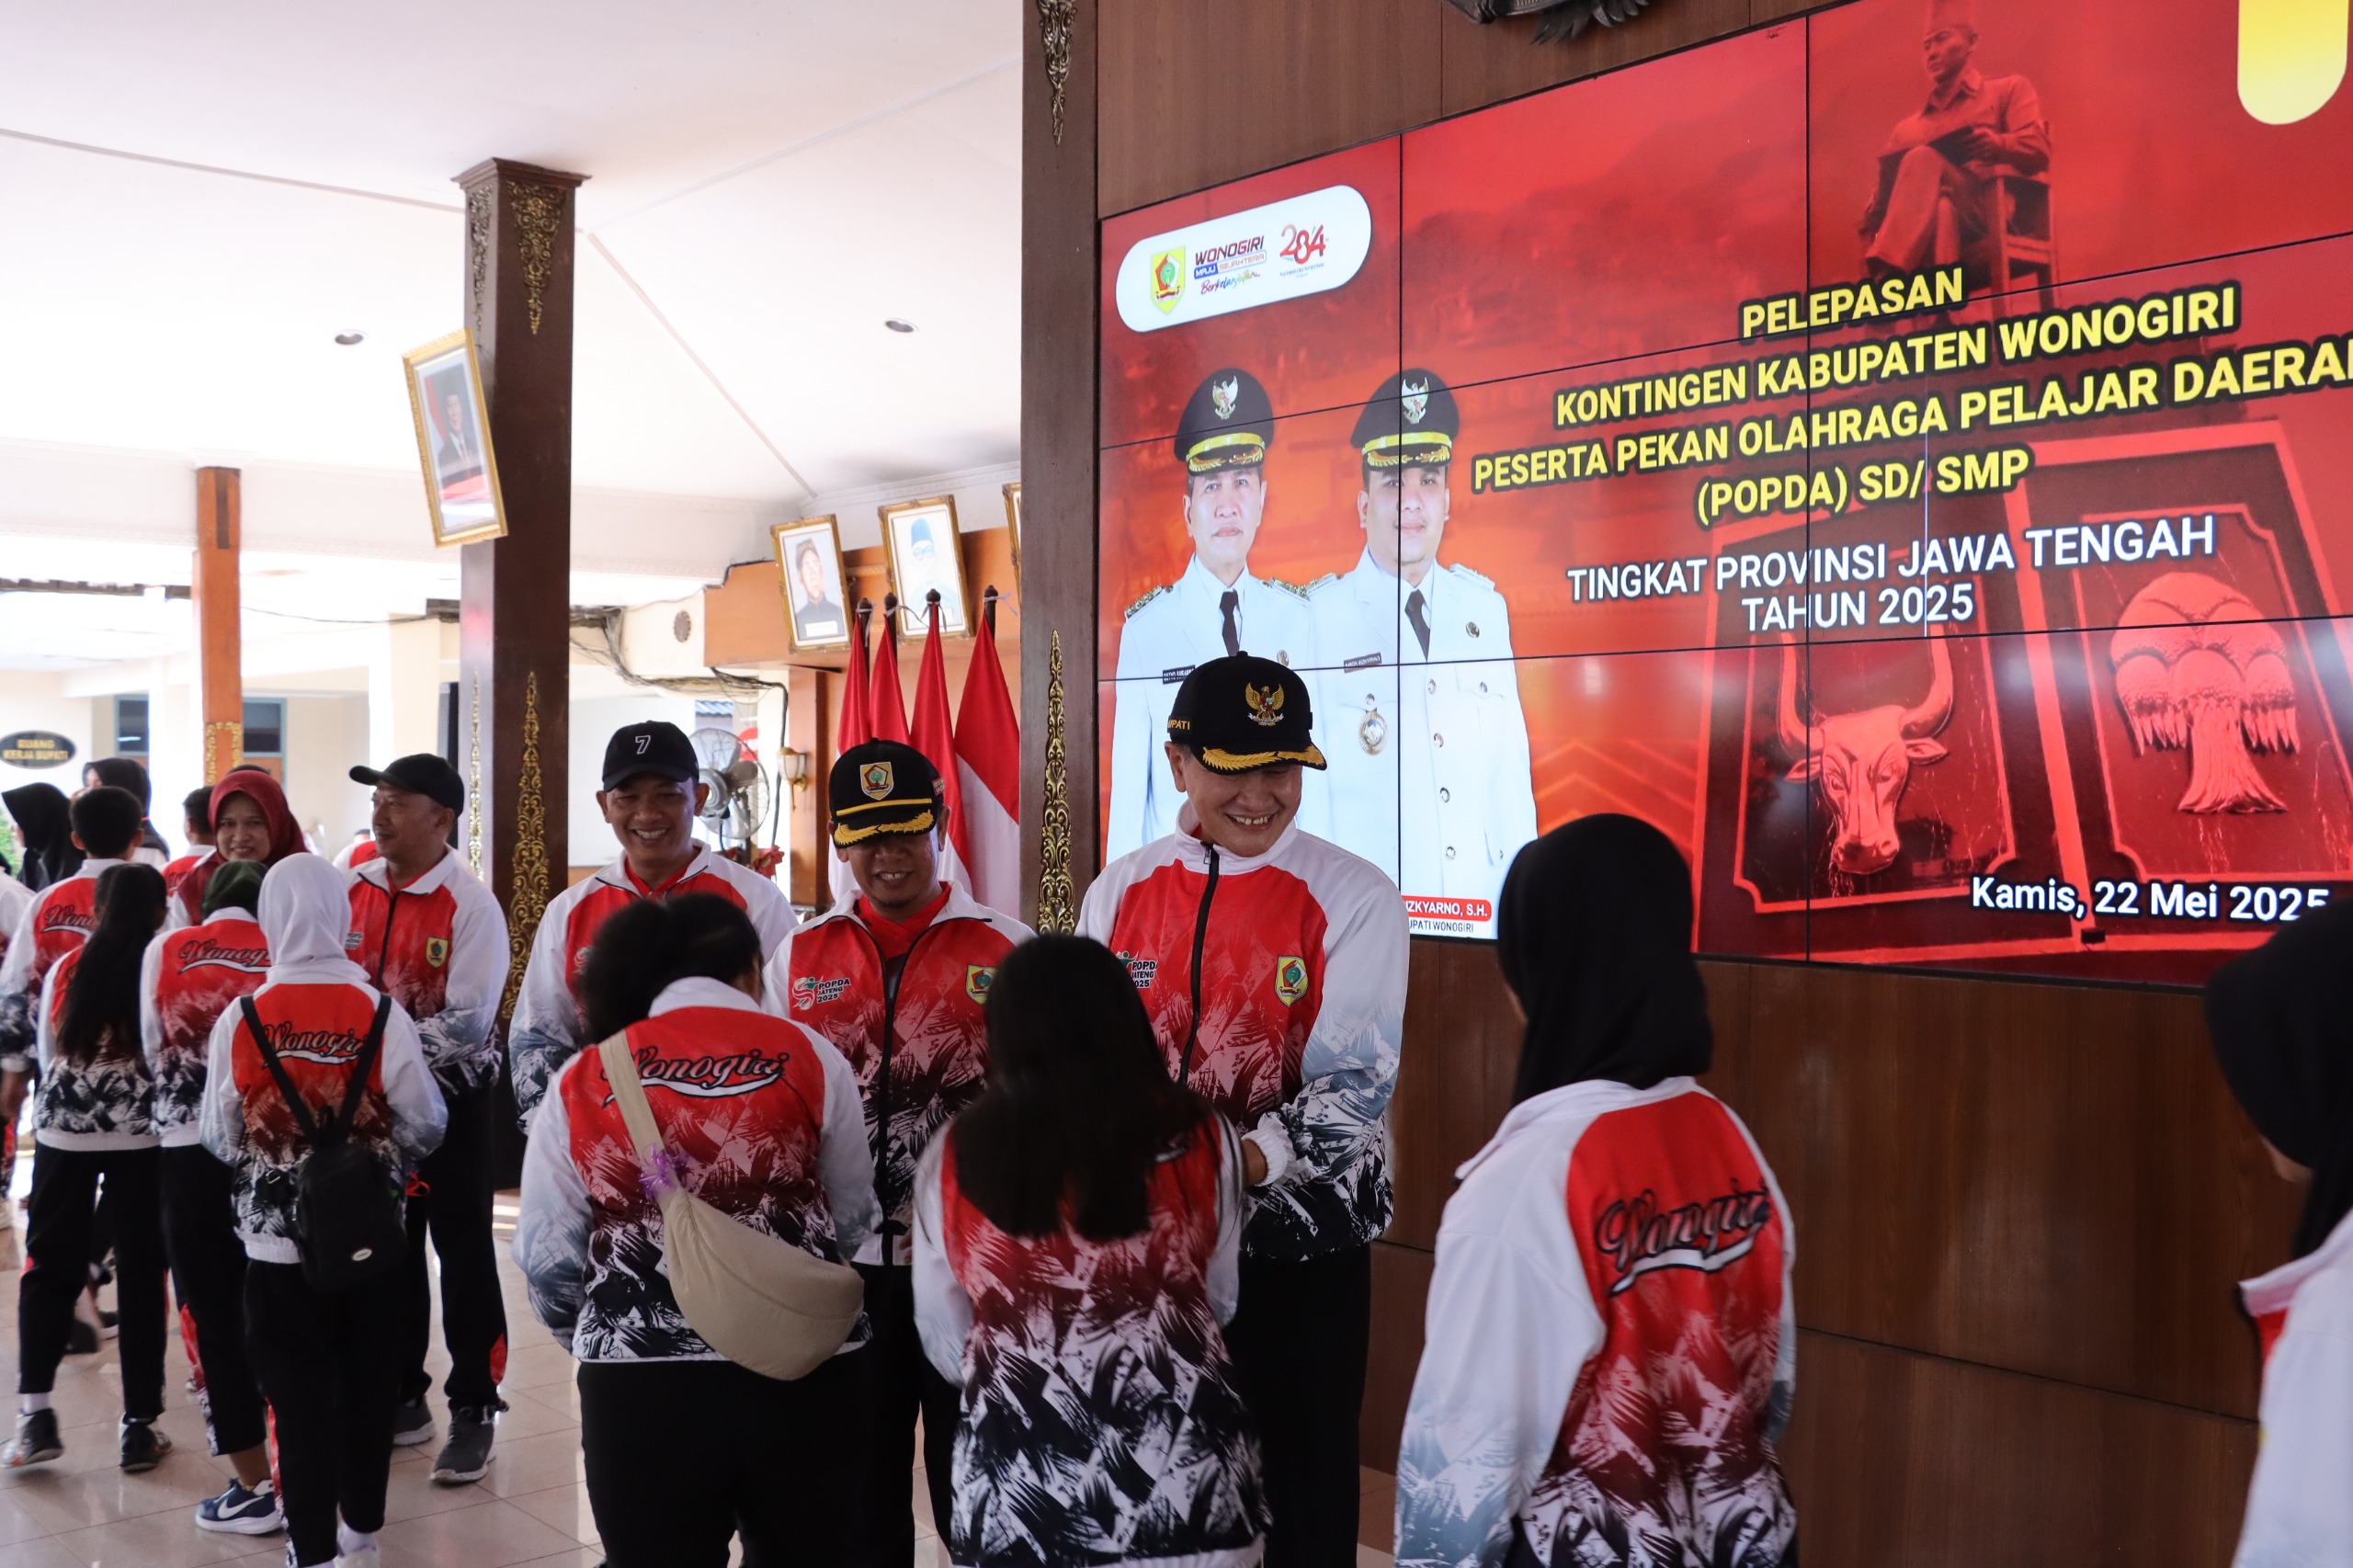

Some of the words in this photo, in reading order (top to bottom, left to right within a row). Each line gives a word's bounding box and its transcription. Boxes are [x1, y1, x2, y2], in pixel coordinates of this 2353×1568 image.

[1195, 235, 1264, 266] WONOGIRI
[1279, 223, 1325, 265] 284
[1195, 265, 1217, 278] MAJU
[1219, 253, 1265, 271] SEJAHTERA
[1742, 267, 1962, 337] PELEPASAN
[1557, 366, 1746, 425] KONTINGEN
[1757, 327, 1986, 394] KABUPATEN
[1999, 287, 2234, 359] WONOGIRI
[1474, 443, 1608, 489] PESERTA
[1617, 426, 1728, 471] PEKAN
[1738, 396, 1949, 456] OLAHRAGA
[1961, 368, 2158, 429] PELAJAR
[2174, 338, 2353, 402] DAERA
[1698, 464, 1847, 526] (POPDA)
[1859, 460, 1926, 501] SD/
[1936, 449, 2029, 493] SMP
[1567, 558, 1708, 601] TINGKAT
[1717, 543, 1885, 590] PROVINSI
[1897, 533, 2016, 578] JAWA
[2025, 515, 2213, 567] TENGAH
[1741, 590, 1866, 631] TAHUN
[1878, 583, 1973, 624] 2025
[635, 734, 651, 755] 7
[1404, 900, 1463, 917] IZKYARNO,
[1466, 903, 1488, 916] S.H.
[1972, 877, 2085, 918] Kamis,
[2095, 881, 2139, 914] 22
[2151, 882, 2217, 918] Mei
[1432, 921, 1474, 933] WONOGIRI
[817, 986, 844, 995] JATENG
[817, 993, 838, 1004] 2025
[818, 977, 850, 990] POPDA
